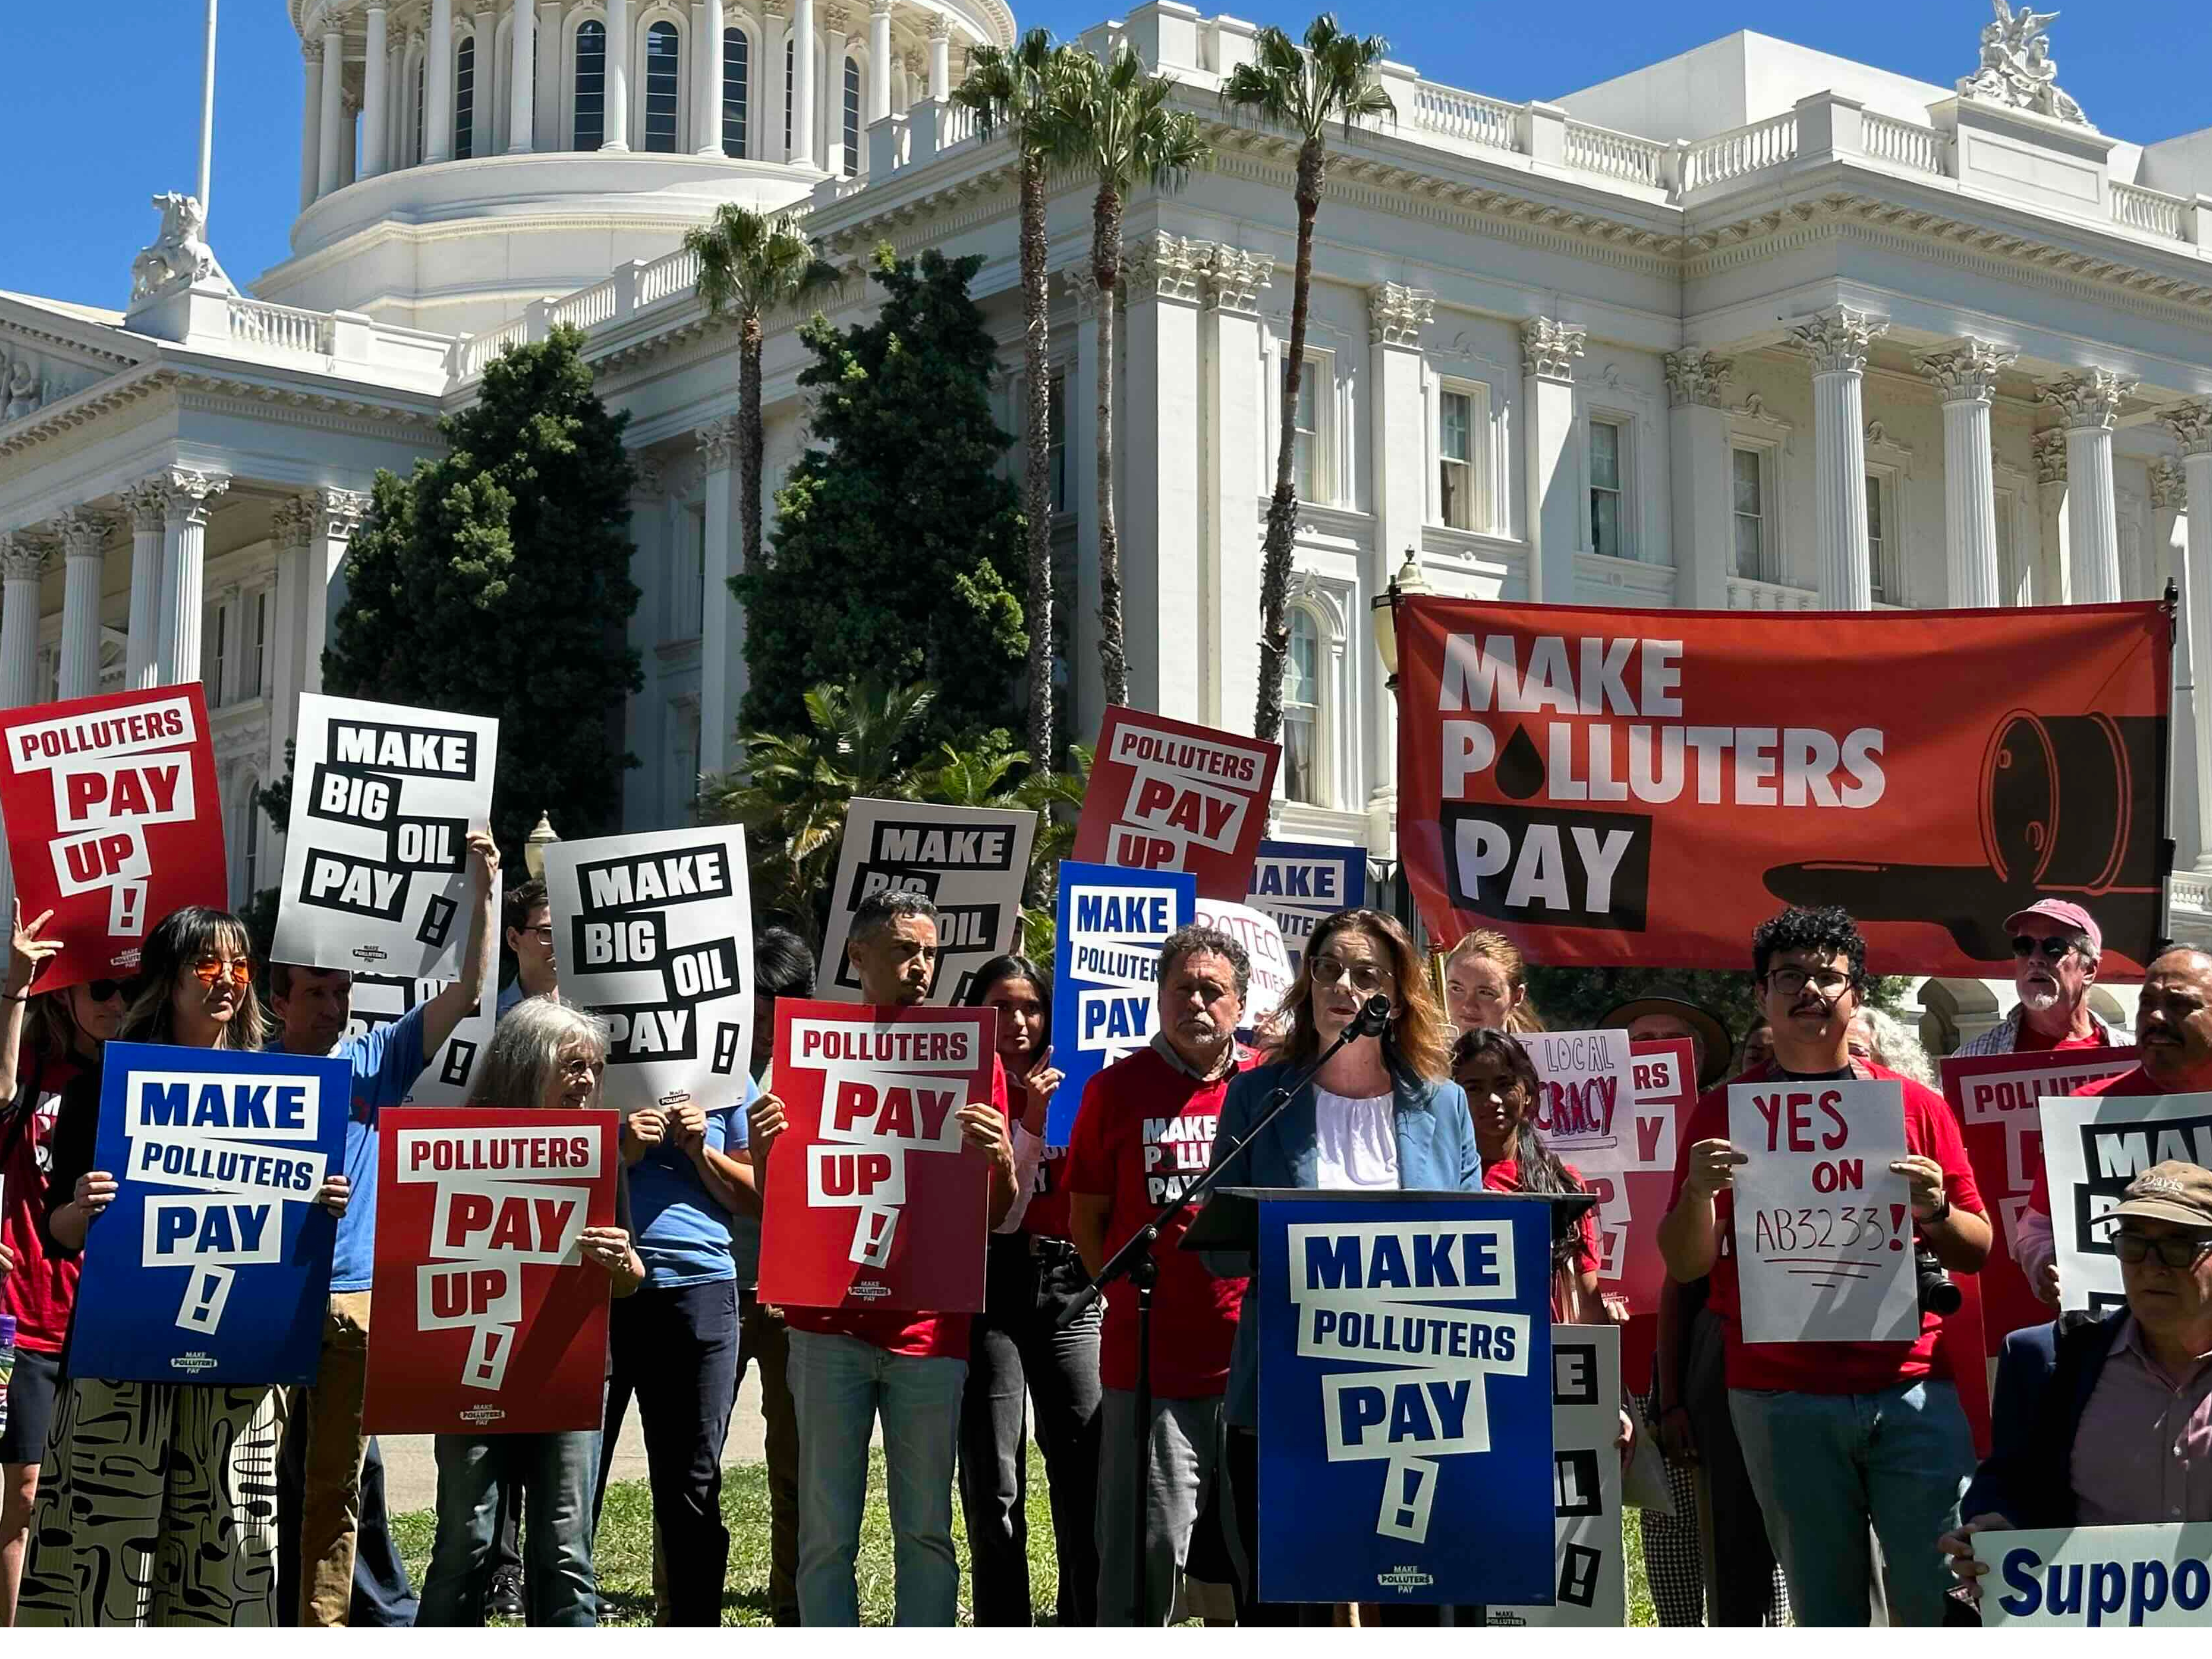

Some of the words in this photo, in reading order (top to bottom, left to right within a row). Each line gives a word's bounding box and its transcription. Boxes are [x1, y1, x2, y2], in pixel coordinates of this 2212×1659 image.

[1438, 633, 1683, 717] MAKE
[20, 709, 183, 761] POLLUTERS
[337, 727, 468, 774] MAKE
[1121, 732, 1255, 782] POLLUTERS
[66, 766, 180, 820] PAY
[320, 772, 389, 821] BIG
[1135, 777, 1238, 840] PAY
[65, 834, 133, 883] UP
[397, 823, 455, 865] OIL
[880, 829, 1006, 864] MAKE
[1117, 833, 1176, 869] UP
[1455, 819, 1634, 913] PAY
[309, 856, 404, 911] PAY
[588, 853, 723, 908] MAKE
[121, 888, 137, 928] !
[428, 902, 449, 939] !
[936, 912, 987, 947] OIL
[1077, 895, 1167, 933] MAKE
[585, 921, 656, 965] BIG
[1077, 946, 1158, 982] POLLUTER
[672, 950, 732, 997] OIL
[604, 1010, 689, 1053] PAY
[1085, 997, 1151, 1040] PAY
[449, 1046, 469, 1079] !
[719, 1029, 734, 1067] !
[803, 1030, 968, 1060] POLLUTERS
[1545, 1036, 1613, 1071] LOCAL
[140, 1082, 306, 1129] MAKE
[834, 1081, 955, 1140] PAY
[1537, 1076, 1617, 1136] CRACY
[1752, 1090, 1848, 1152] YES
[1143, 1115, 1216, 1144] MAKE
[142, 1142, 314, 1190] POLLUTERS
[411, 1137, 589, 1171] POLLUTERS
[821, 1154, 891, 1196] UP
[1812, 1158, 1864, 1193] ON
[155, 1204, 269, 1255] PAY
[445, 1193, 576, 1252] PAY
[864, 1213, 888, 1256] !
[1305, 1234, 1500, 1289] MAKE
[192, 1274, 222, 1322] !
[431, 1269, 507, 1319] UP
[476, 1333, 503, 1379] !
[1313, 1310, 1515, 1362] POLLUTERS
[1338, 1380, 1471, 1446] PAY
[1395, 1468, 1424, 1528] !
[1398, 1585, 1413, 1594] PAY
[1571, 1553, 1591, 1597] !
